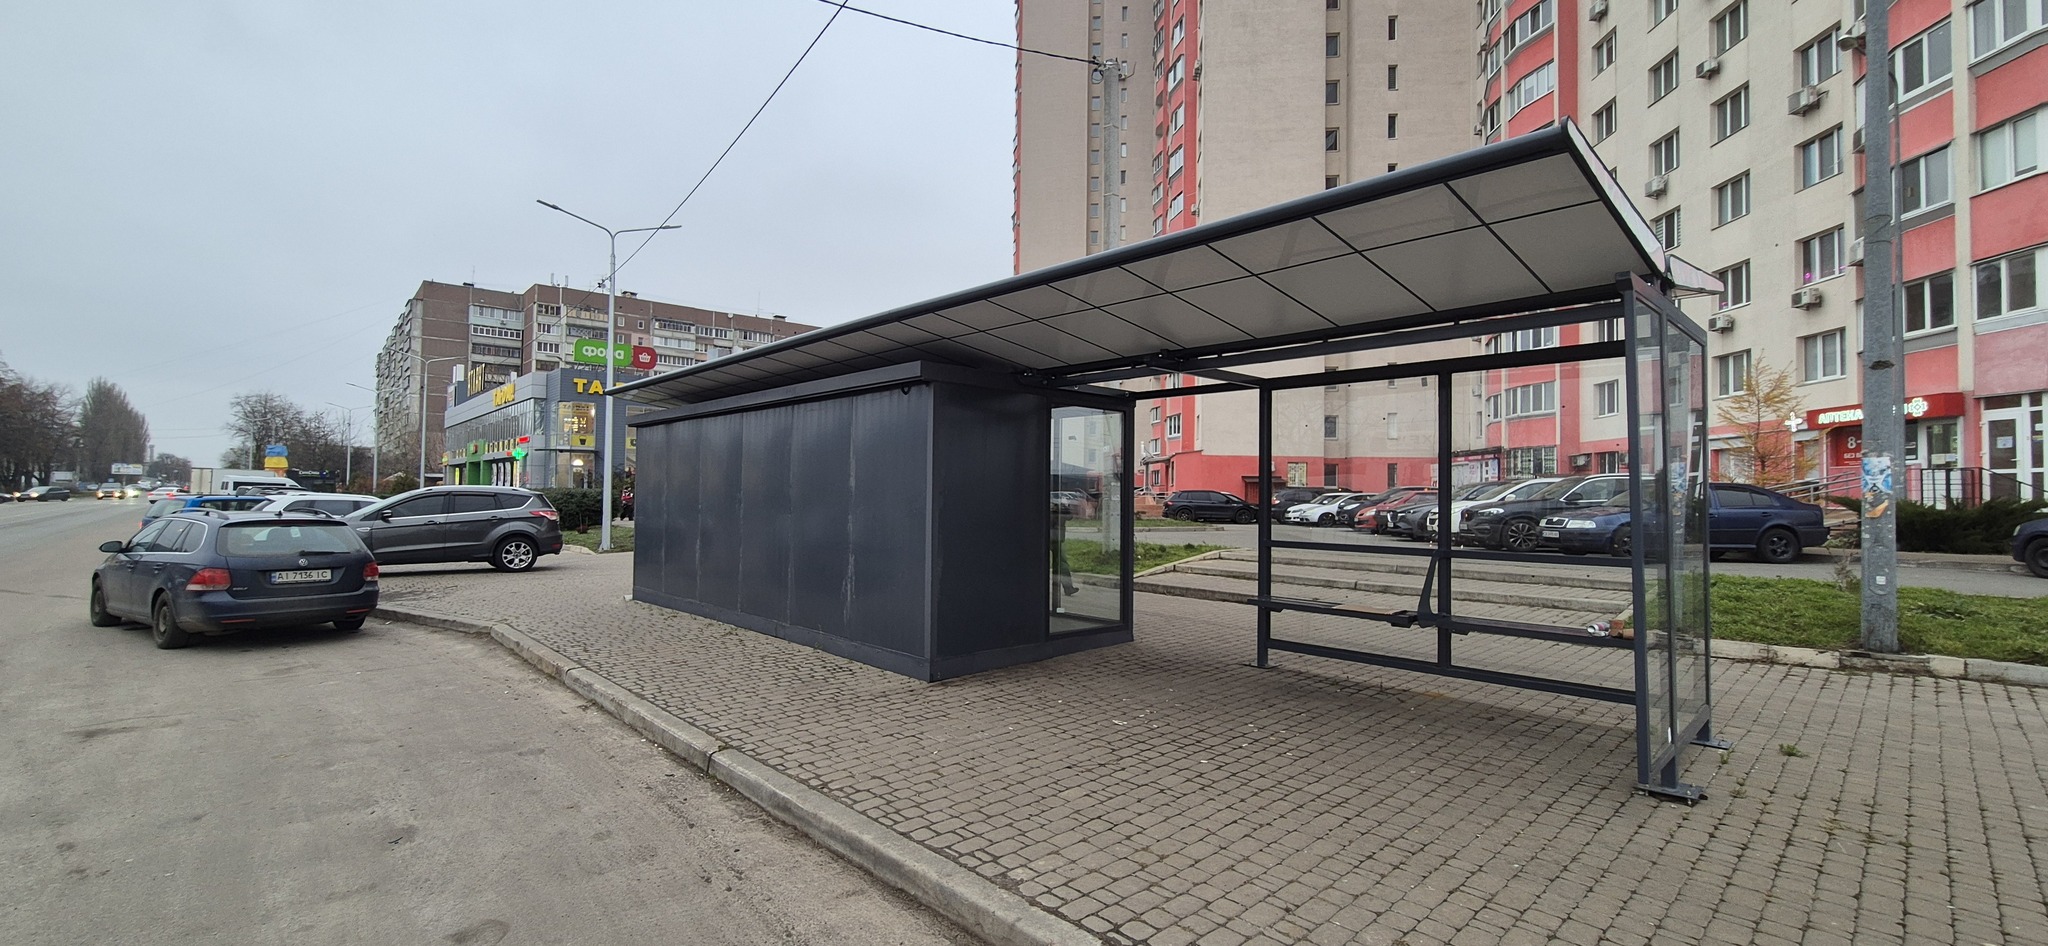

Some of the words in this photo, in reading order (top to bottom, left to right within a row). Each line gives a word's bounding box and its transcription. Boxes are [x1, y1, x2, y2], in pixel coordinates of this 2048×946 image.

[582, 346, 625, 360] фоа
[1818, 408, 1864, 424] АПТЕКА
[277, 572, 289, 580] AI
[292, 571, 314, 580] 7136
[316, 570, 328, 579] IC
